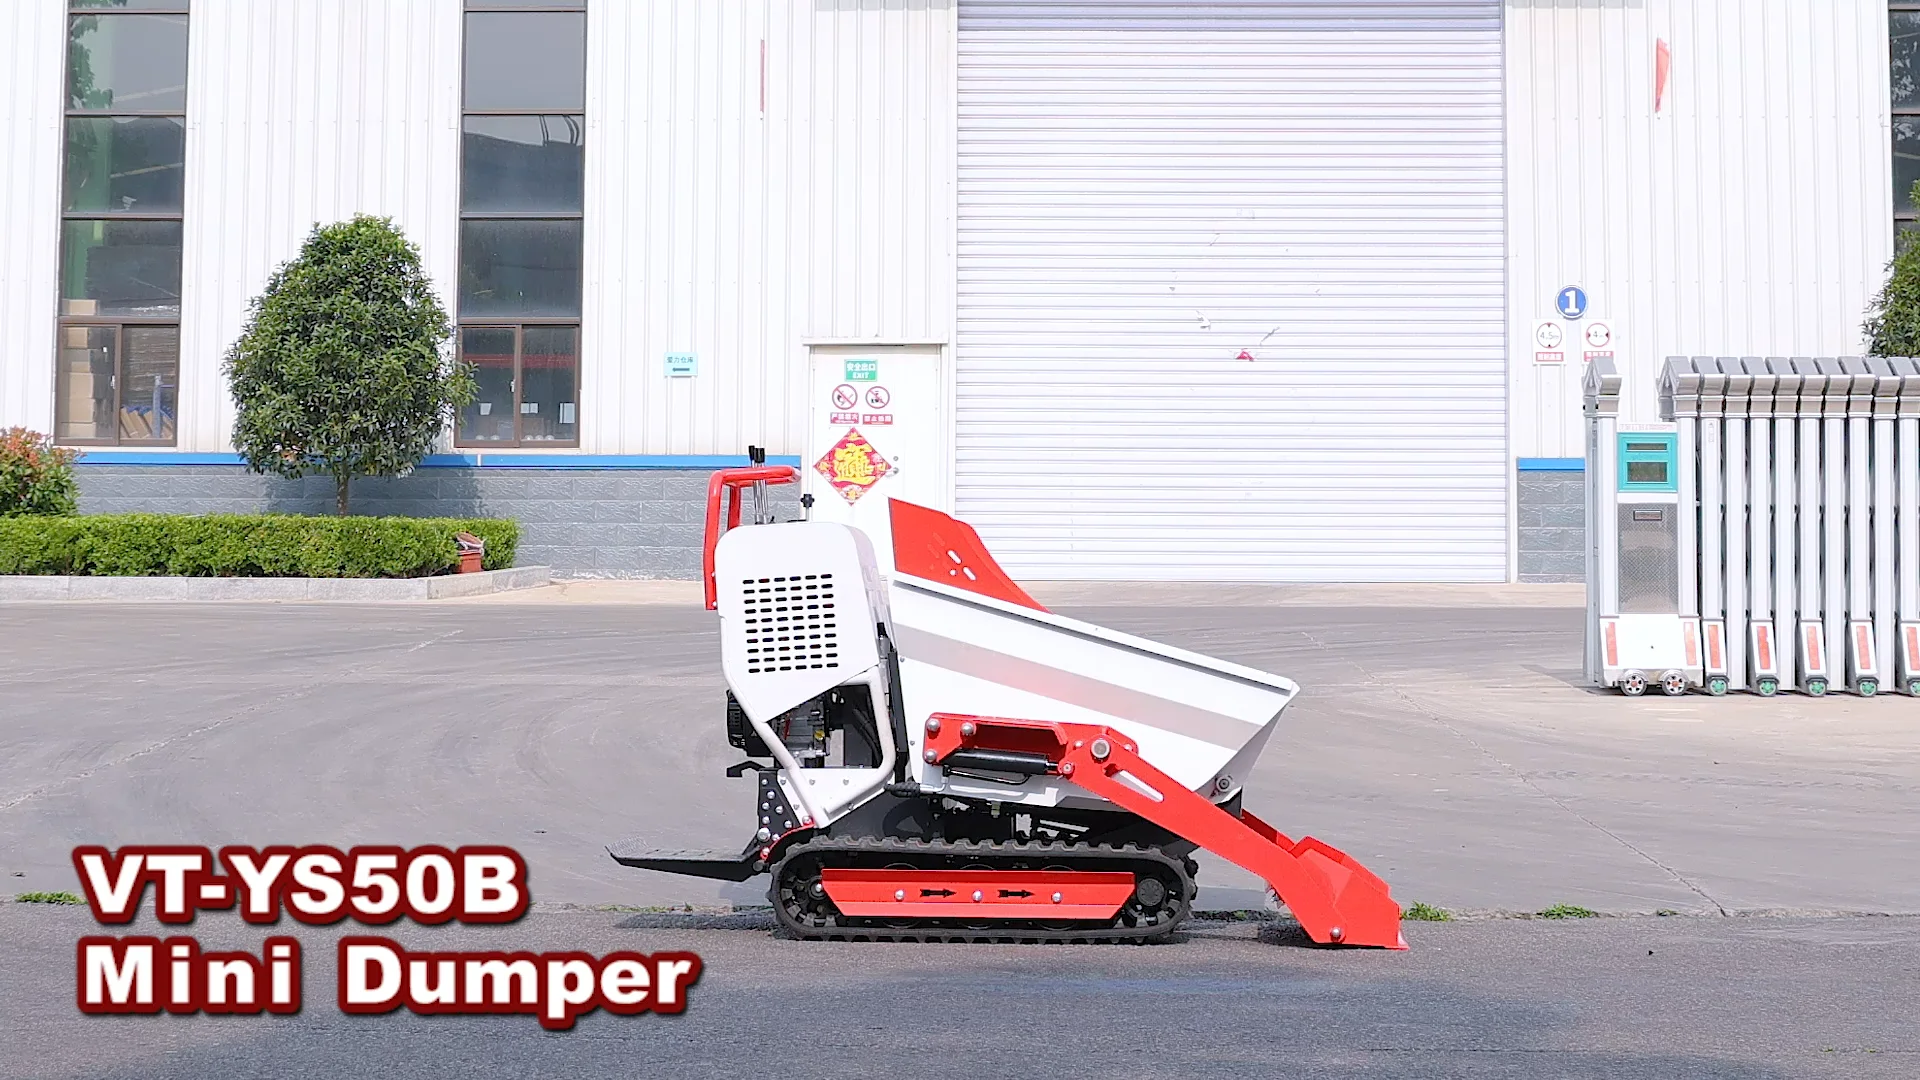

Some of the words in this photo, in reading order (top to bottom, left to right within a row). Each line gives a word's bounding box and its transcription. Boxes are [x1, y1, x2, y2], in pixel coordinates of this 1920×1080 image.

[1564, 290, 1580, 314] 1
[846, 362, 876, 371] 安全出口
[852, 371, 870, 379] EXIT
